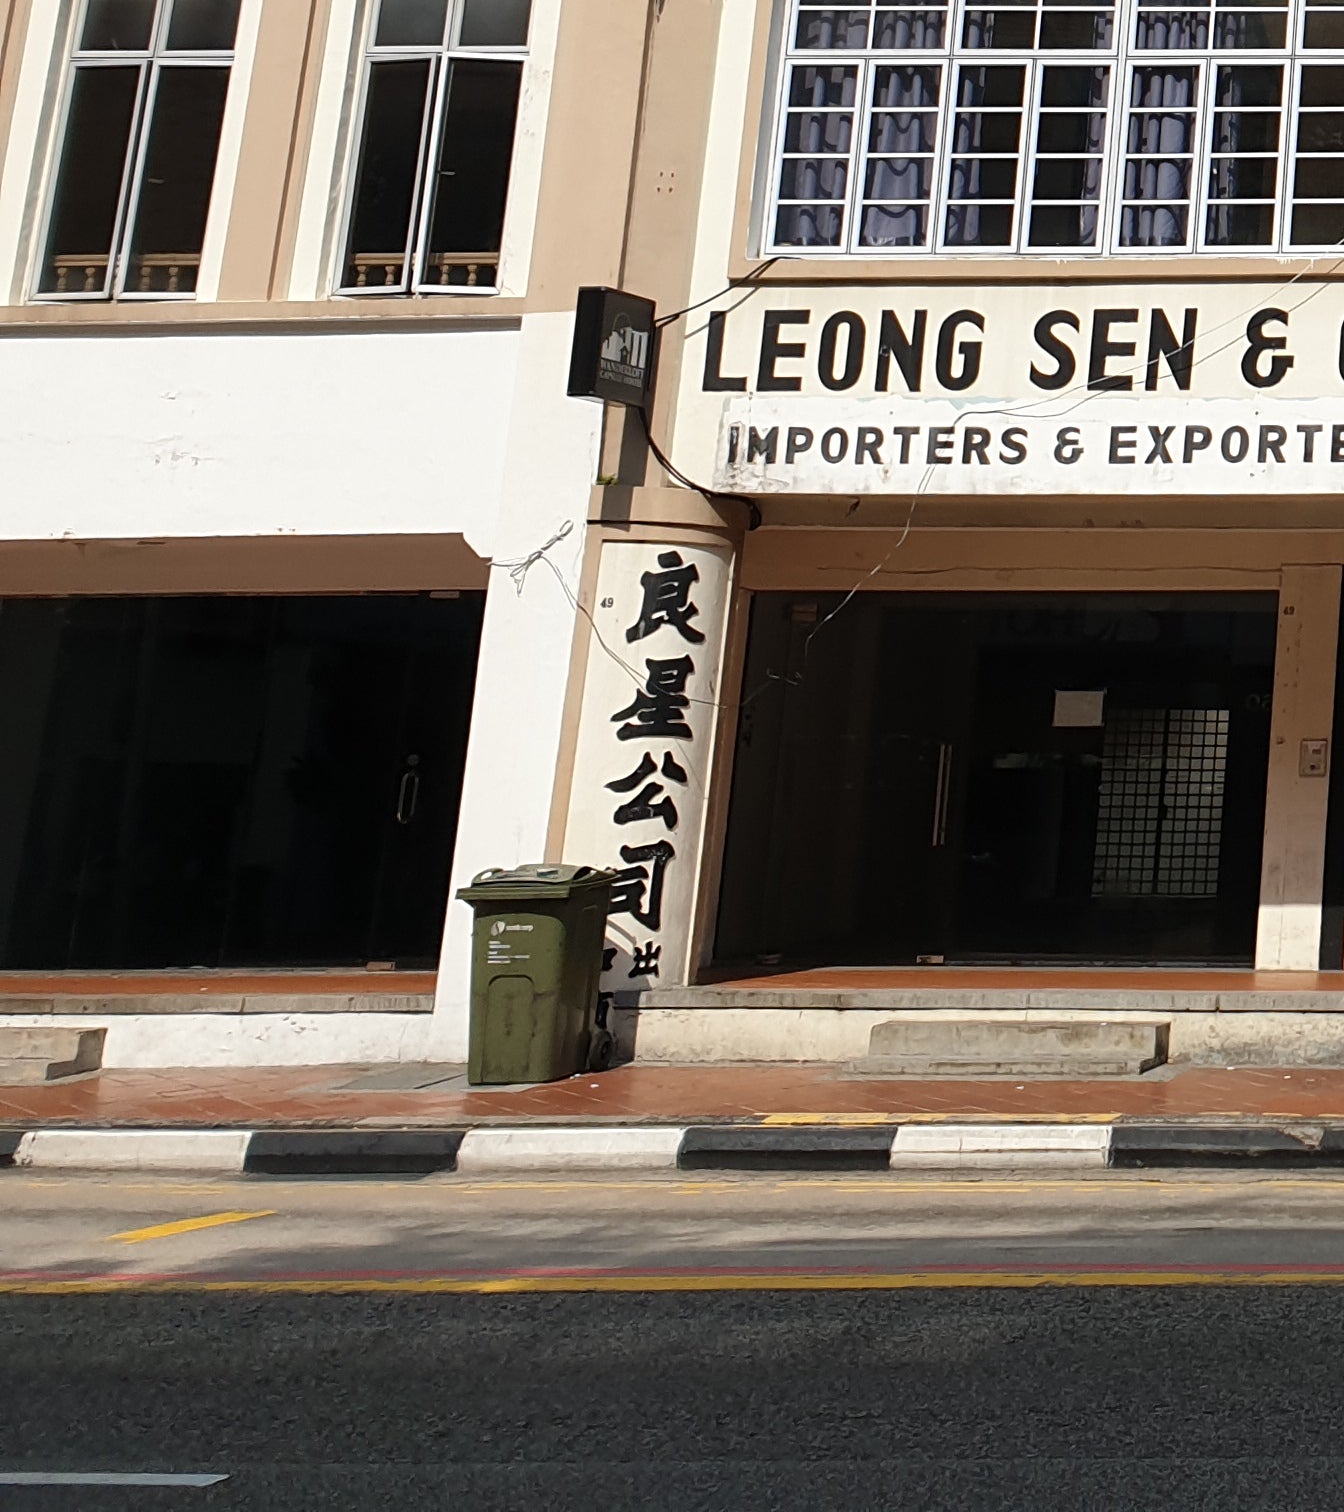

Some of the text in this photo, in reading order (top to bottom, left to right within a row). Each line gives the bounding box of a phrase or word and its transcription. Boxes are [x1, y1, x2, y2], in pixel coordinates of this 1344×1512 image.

[702, 308, 985, 393] LEONG
[1029, 306, 1199, 392] SEN
[1241, 306, 1295, 388] &
[726, 425, 1028, 465] IMPORTERS
[1053, 425, 1084, 465] &
